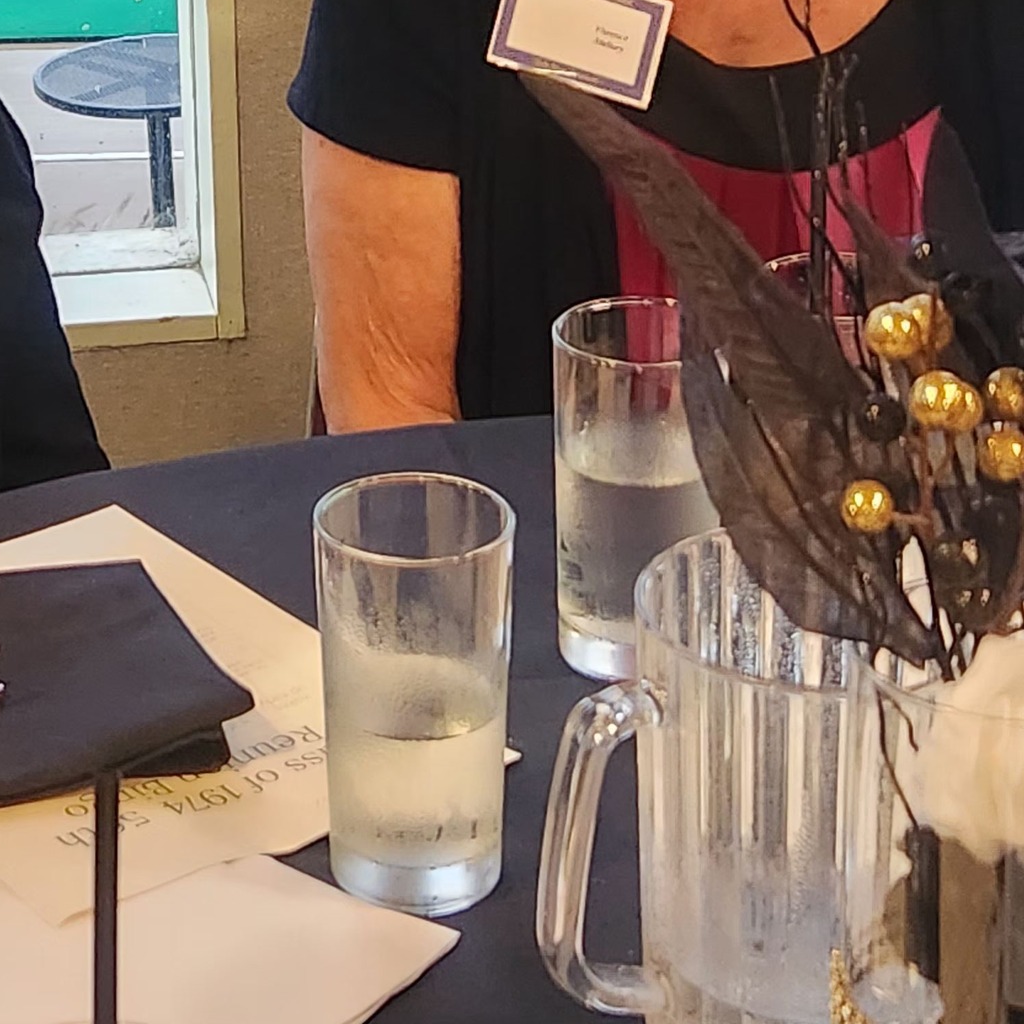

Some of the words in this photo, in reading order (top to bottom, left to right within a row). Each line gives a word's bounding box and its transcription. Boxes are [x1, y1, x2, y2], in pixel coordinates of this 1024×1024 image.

[176, 724, 323, 783] Reunin
[243, 769, 279, 794] of
[162, 783, 242, 815] 1974
[56, 810, 150, 847] 5th
